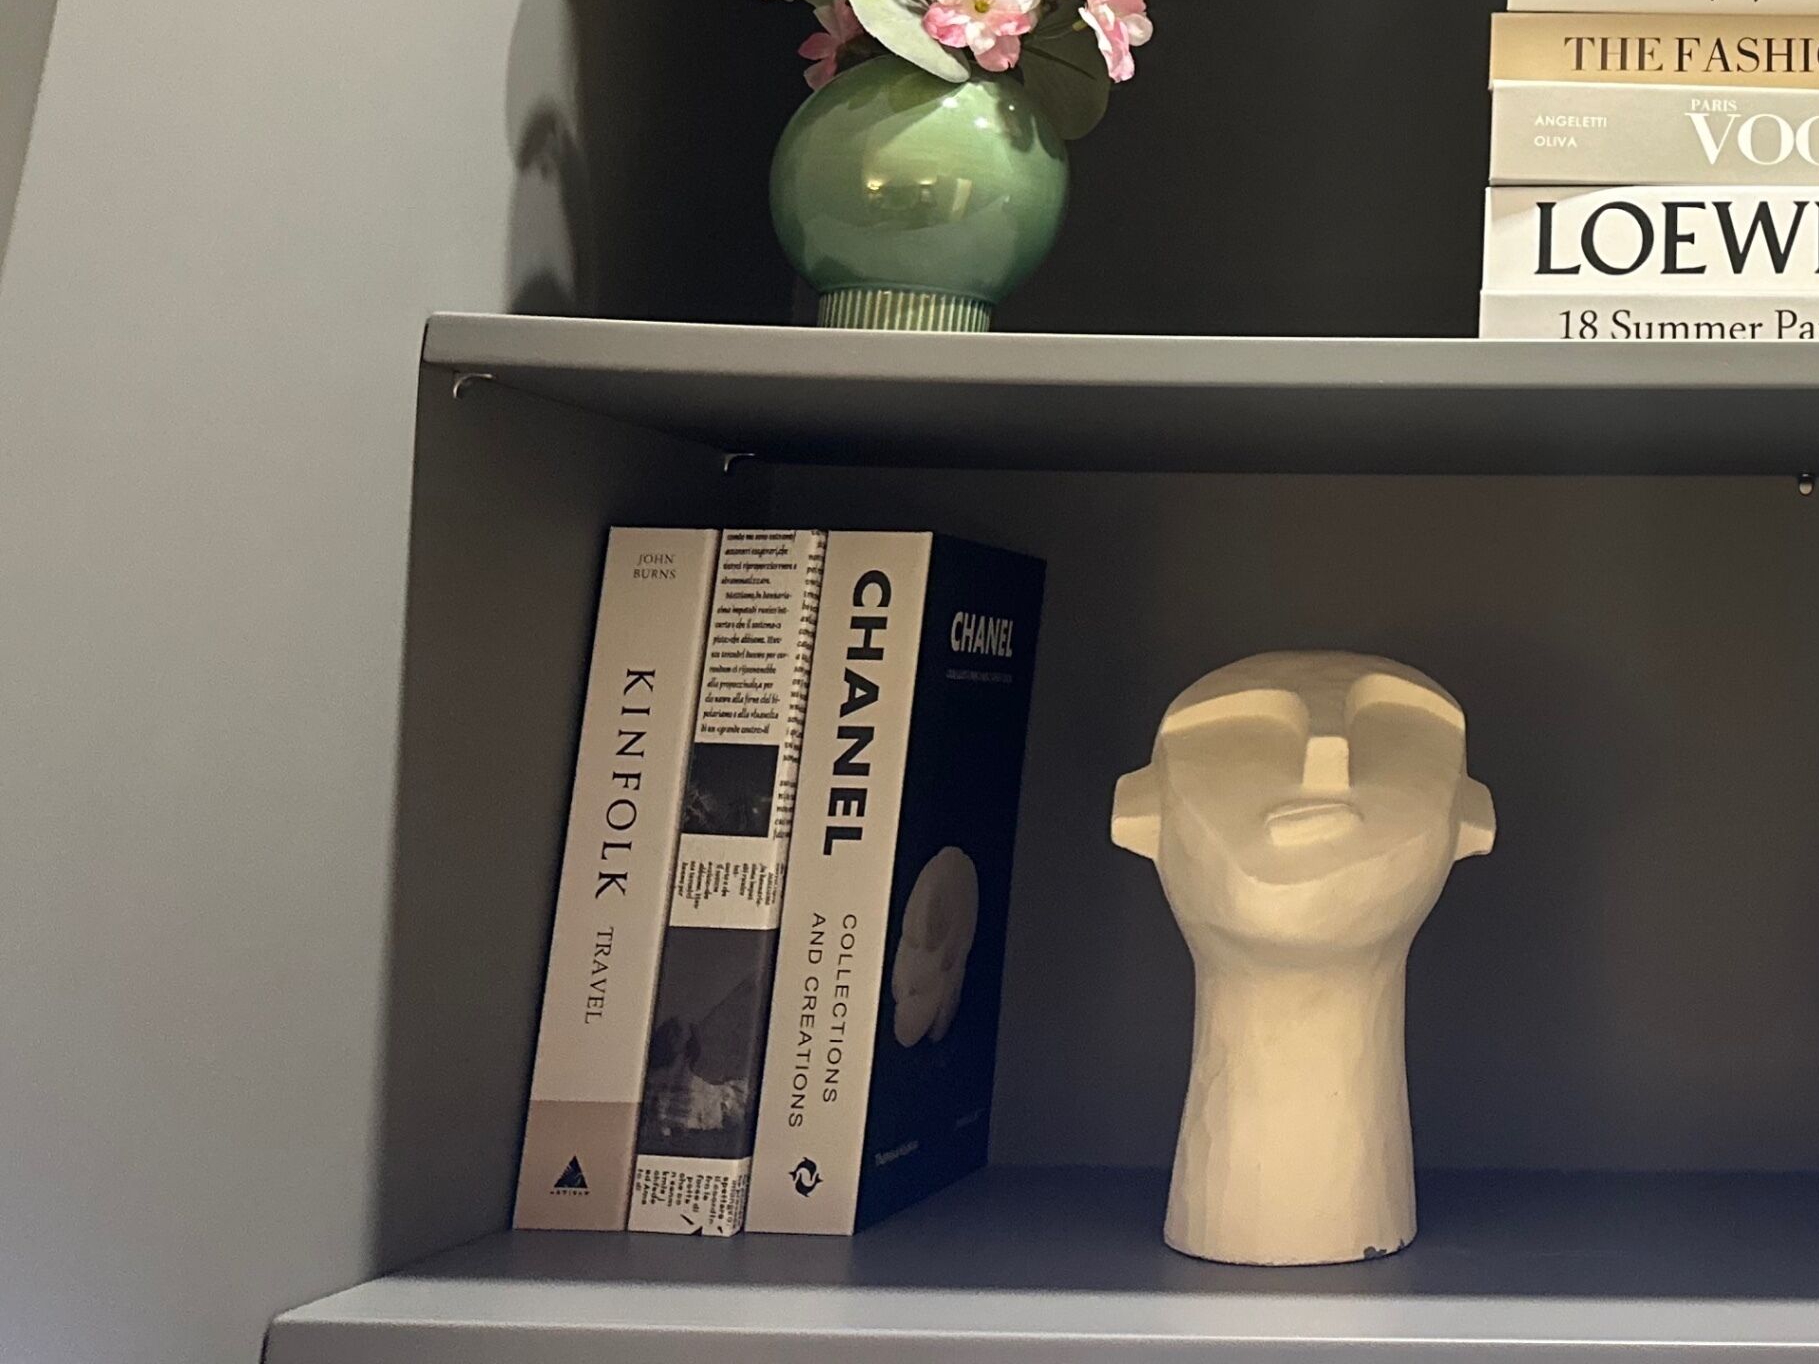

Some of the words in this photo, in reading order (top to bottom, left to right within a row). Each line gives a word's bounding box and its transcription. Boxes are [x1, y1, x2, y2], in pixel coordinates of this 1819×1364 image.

[1564, 36, 1664, 71] THE
[1534, 115, 1607, 128] ANGELETTI
[1691, 98, 1737, 112] PARIS
[1534, 135, 1577, 148] OLIVA
[1560, 310, 1598, 339] 18
[1611, 309, 1763, 340] Summer
[633, 568, 676, 579] BURNS
[637, 554, 673, 566] JOHN
[950, 611, 1013, 657] CHANEL
[822, 568, 893, 857] CHANEL
[594, 667, 656, 899] KINFOLK
[808, 912, 826, 965] AND
[584, 926, 614, 1024] TRAVEL
[820, 914, 857, 1103] COLLECTIONS
[788, 976, 819, 1128] CREATIONS
